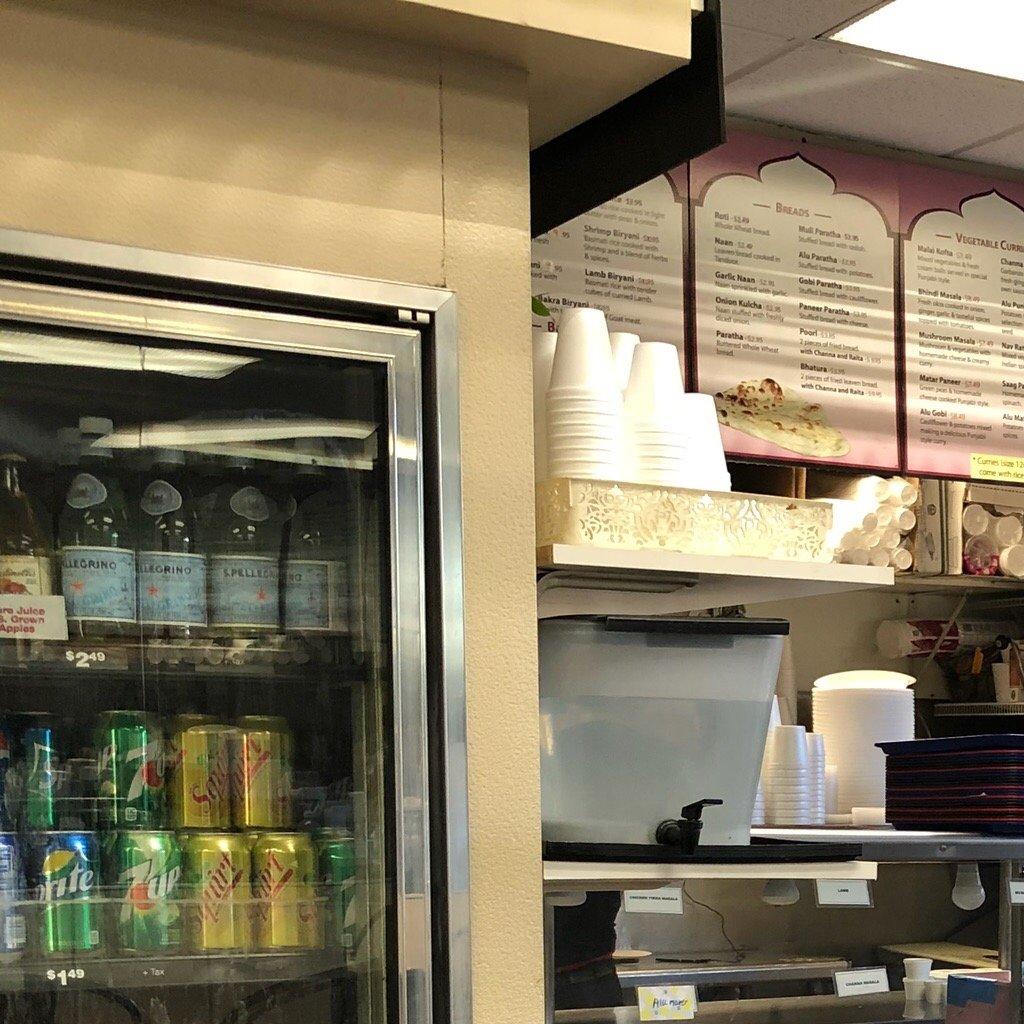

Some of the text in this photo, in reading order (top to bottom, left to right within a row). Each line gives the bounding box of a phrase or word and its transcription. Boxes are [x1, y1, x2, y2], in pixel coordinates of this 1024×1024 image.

[919, 331, 975, 346] Mushroom Masala
[977, 458, 999, 466] Curries
[979, 470, 996, 478] come
[998, 470, 1012, 478] with
[1013, 472, 1024, 480] rice
[17, 607, 45, 615] Juice
[11, 615, 45, 624] Grown
[0, 624, 35, 634] Apples
